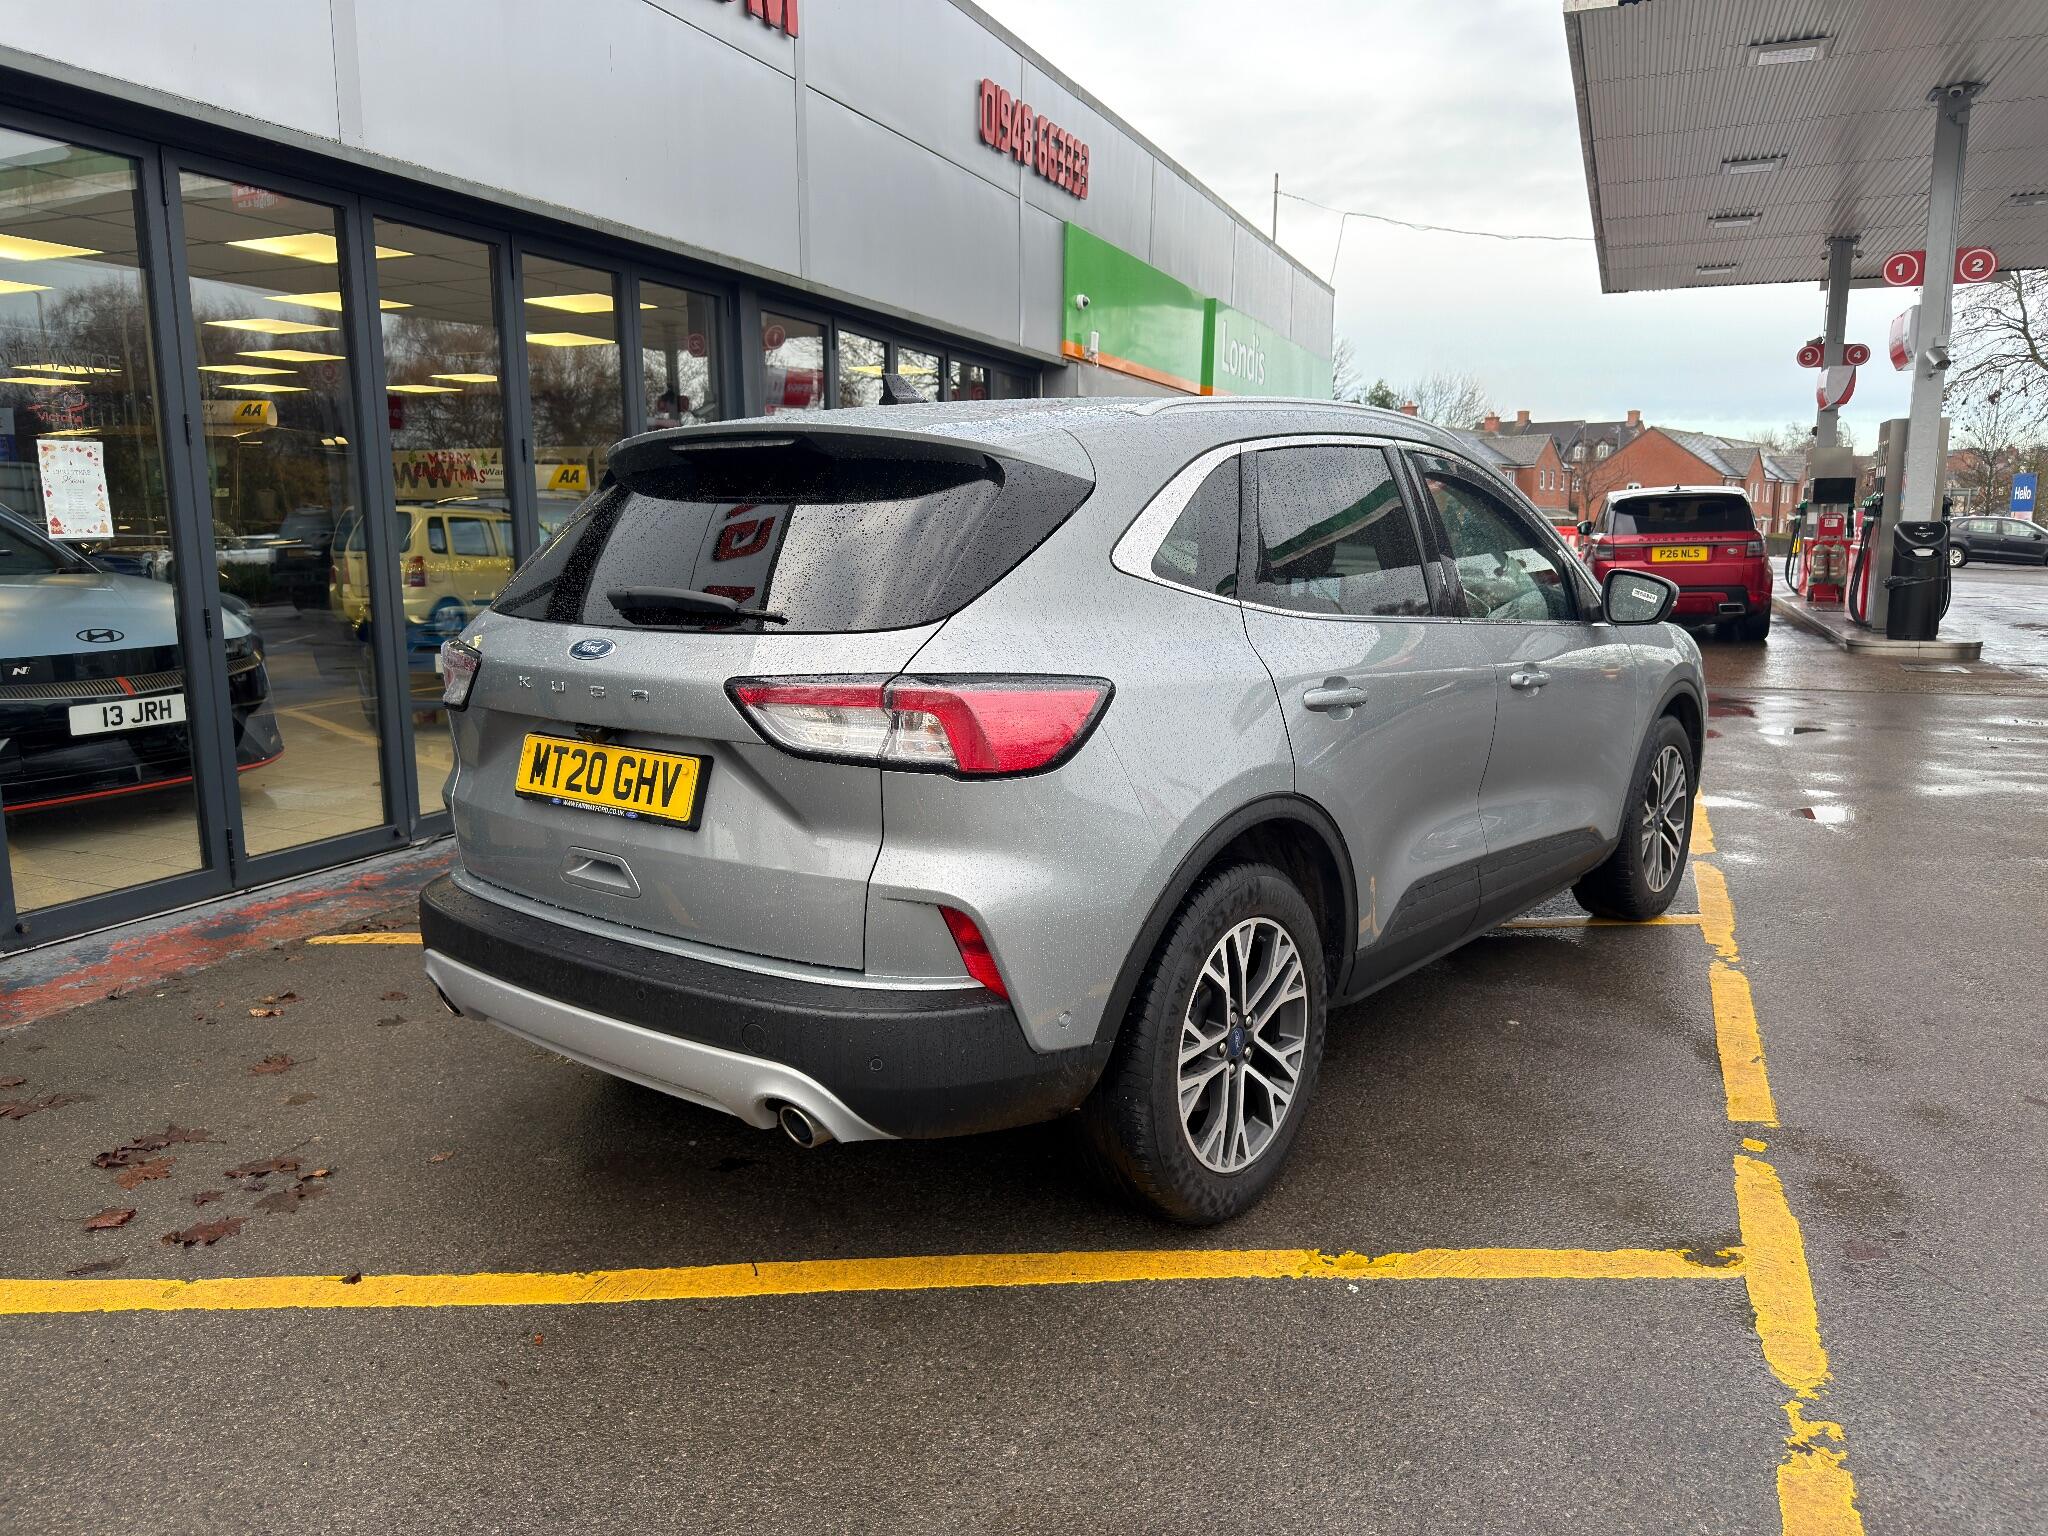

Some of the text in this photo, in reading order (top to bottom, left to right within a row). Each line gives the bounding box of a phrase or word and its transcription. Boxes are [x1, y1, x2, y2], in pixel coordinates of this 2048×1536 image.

[981, 79, 1033, 167] 01948
[1895, 263, 1903, 275] 1
[1972, 258, 1984, 272] 2
[1221, 320, 1266, 386] Londis
[242, 403, 262, 416] AA
[427, 452, 472, 465] MERRY
[558, 469, 580, 483] AA
[2014, 486, 2032, 500] Hello
[1659, 549, 1700, 558] P26 NLS
[519, 676, 650, 703] KUGA
[102, 698, 172, 728] 13 JRH
[529, 742, 682, 808] MT20 GHV
